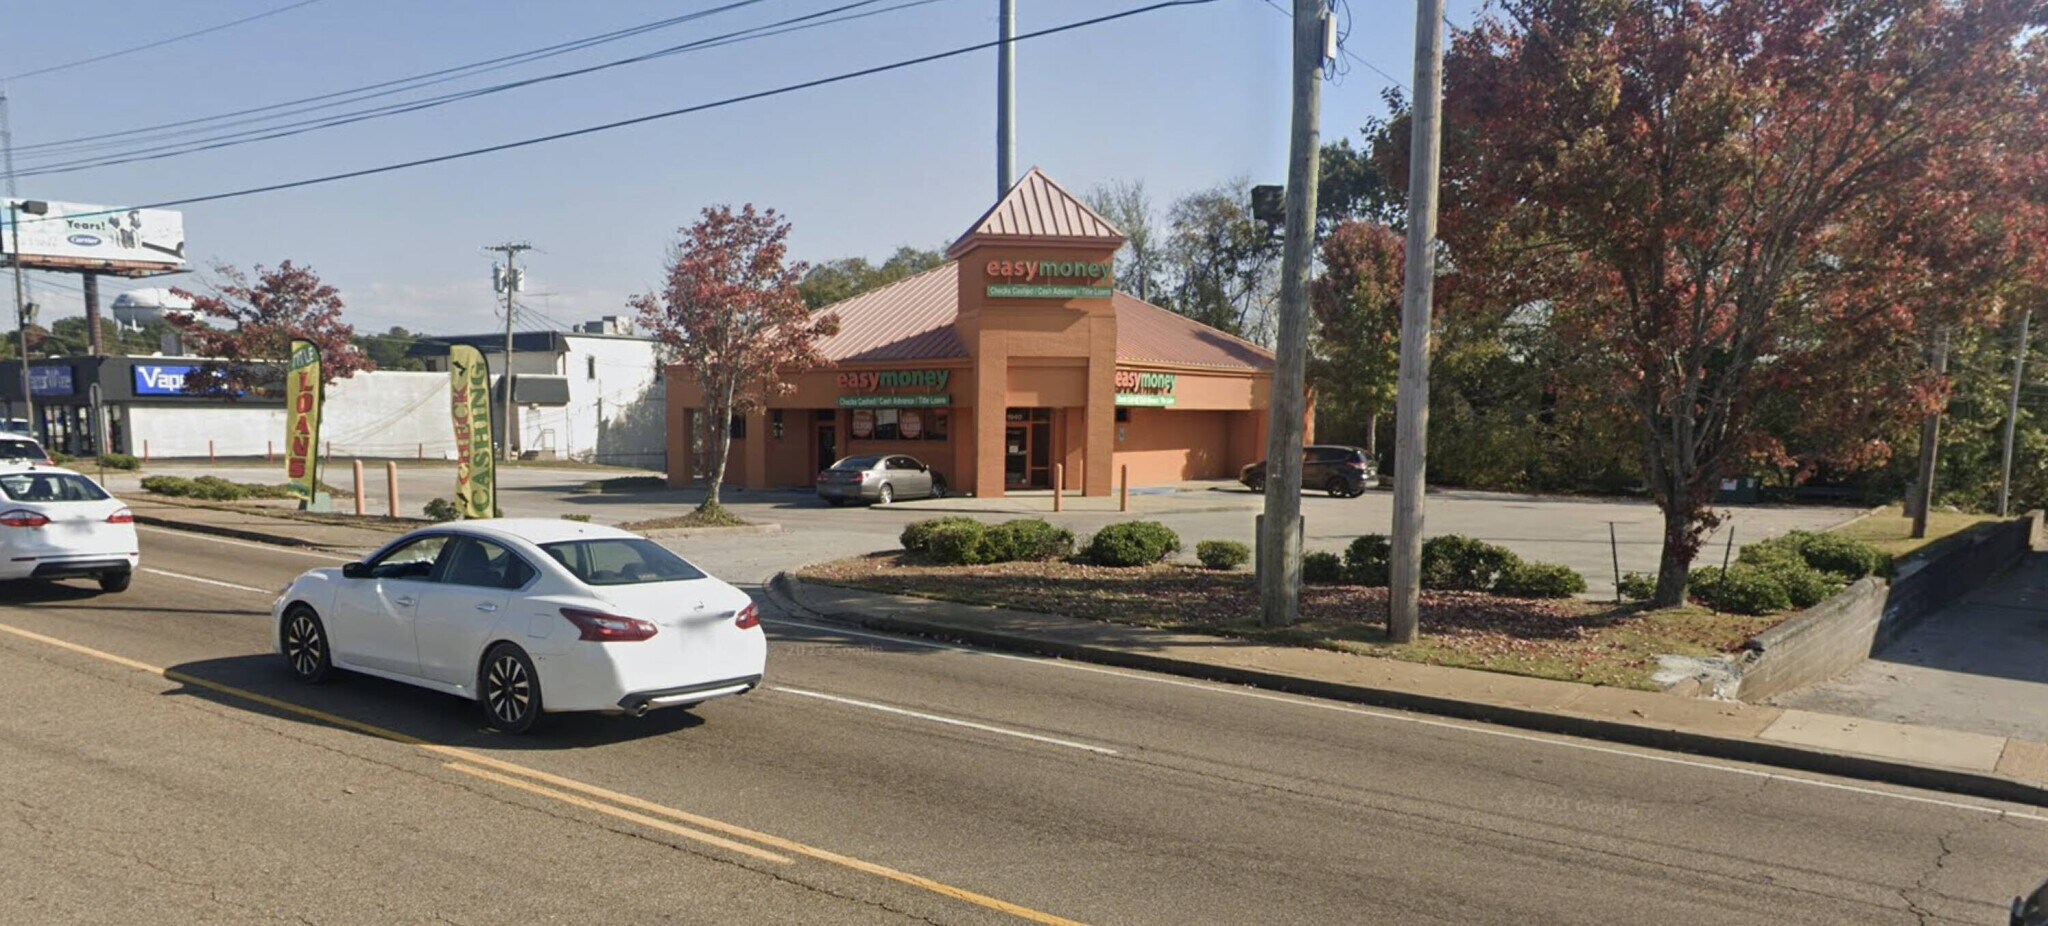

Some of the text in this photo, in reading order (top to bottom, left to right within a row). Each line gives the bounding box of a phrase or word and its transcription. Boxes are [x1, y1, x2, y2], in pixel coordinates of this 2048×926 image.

[67, 219, 105, 231] Years!
[987, 260, 1112, 281] easymoney
[837, 370, 950, 392] easymoney
[1115, 371, 1176, 392] easymoney
[289, 371, 314, 478] LOANS
[452, 384, 471, 486] CHECK
[470, 362, 491, 512] CASHING
